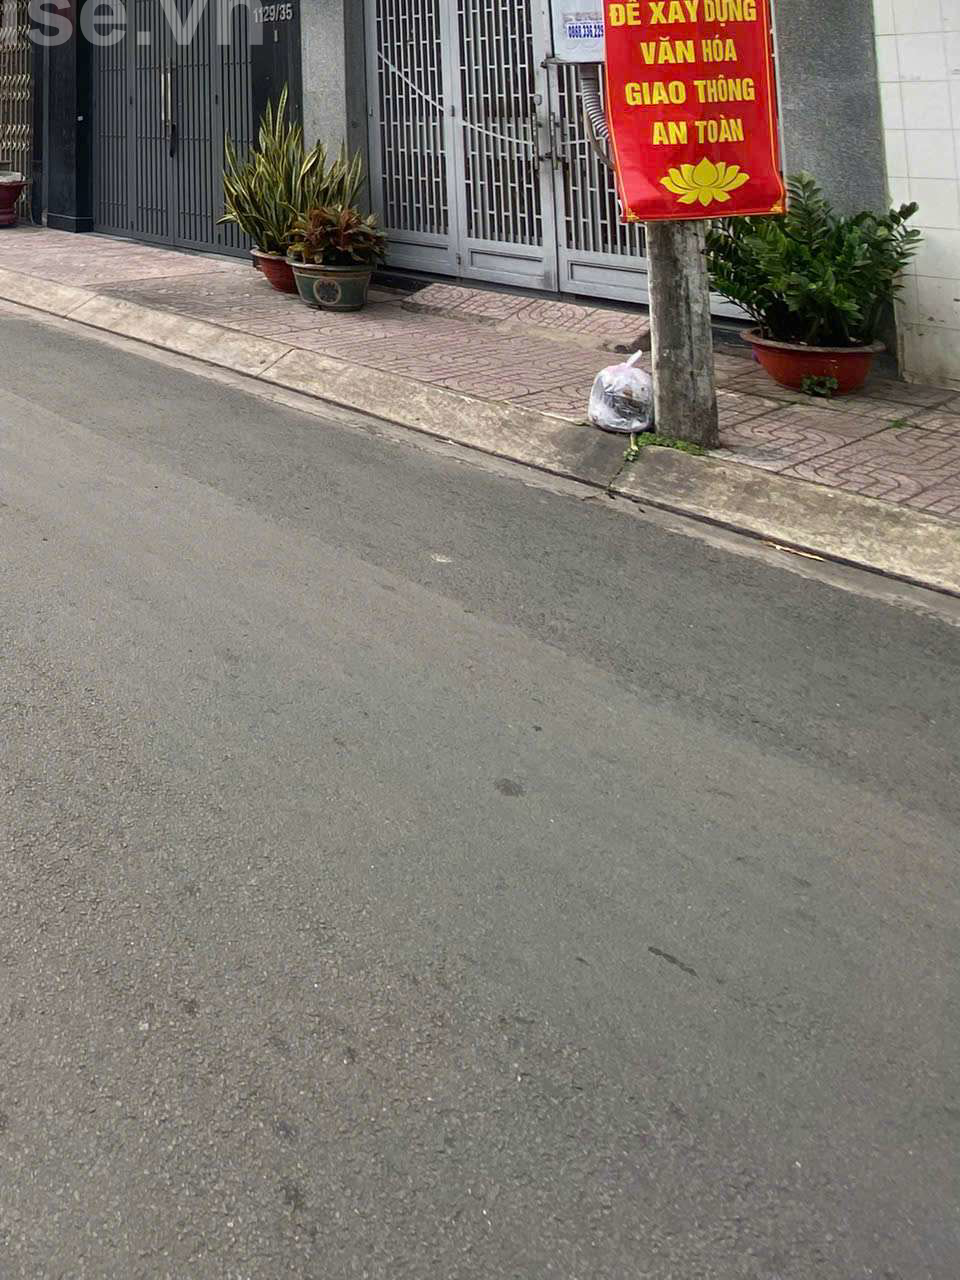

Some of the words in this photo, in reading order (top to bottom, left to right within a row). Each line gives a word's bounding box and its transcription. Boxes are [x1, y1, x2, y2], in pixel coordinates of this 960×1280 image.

[253, 3, 293, 23] 1129/35
[640, 36, 696, 65] VĂN
[701, 34, 738, 63] HÓA
[625, 81, 687, 106] GIAO
[693, 74, 756, 104] THÔNG
[652, 121, 688, 145] AN
[694, 114, 745, 144] TOÀN
